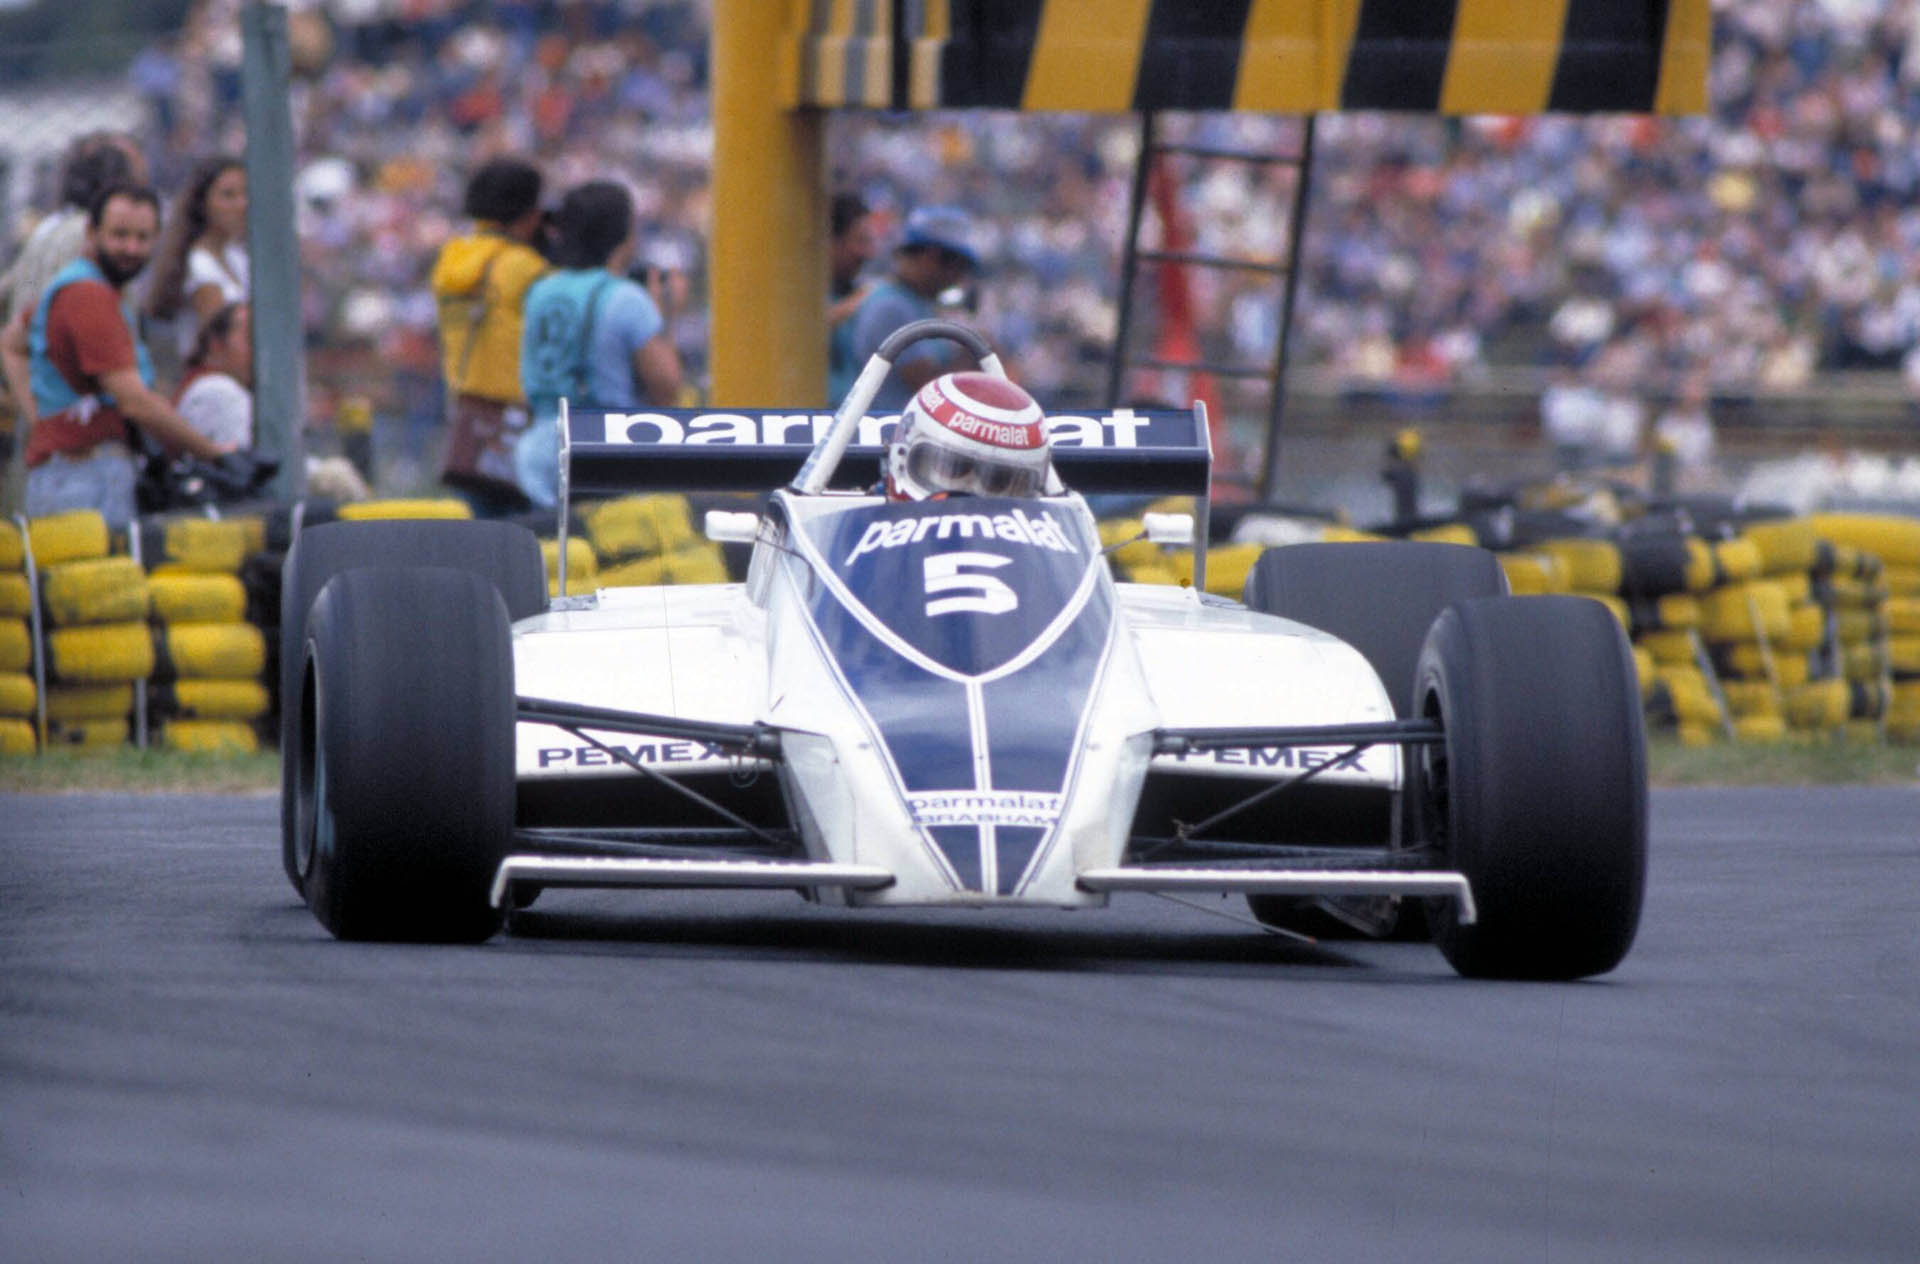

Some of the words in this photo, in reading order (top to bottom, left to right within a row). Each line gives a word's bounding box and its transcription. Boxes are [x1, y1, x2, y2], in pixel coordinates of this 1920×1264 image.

[948, 411, 1030, 446] parmalat
[844, 508, 1078, 567] parmalat
[923, 551, 1019, 617] 5
